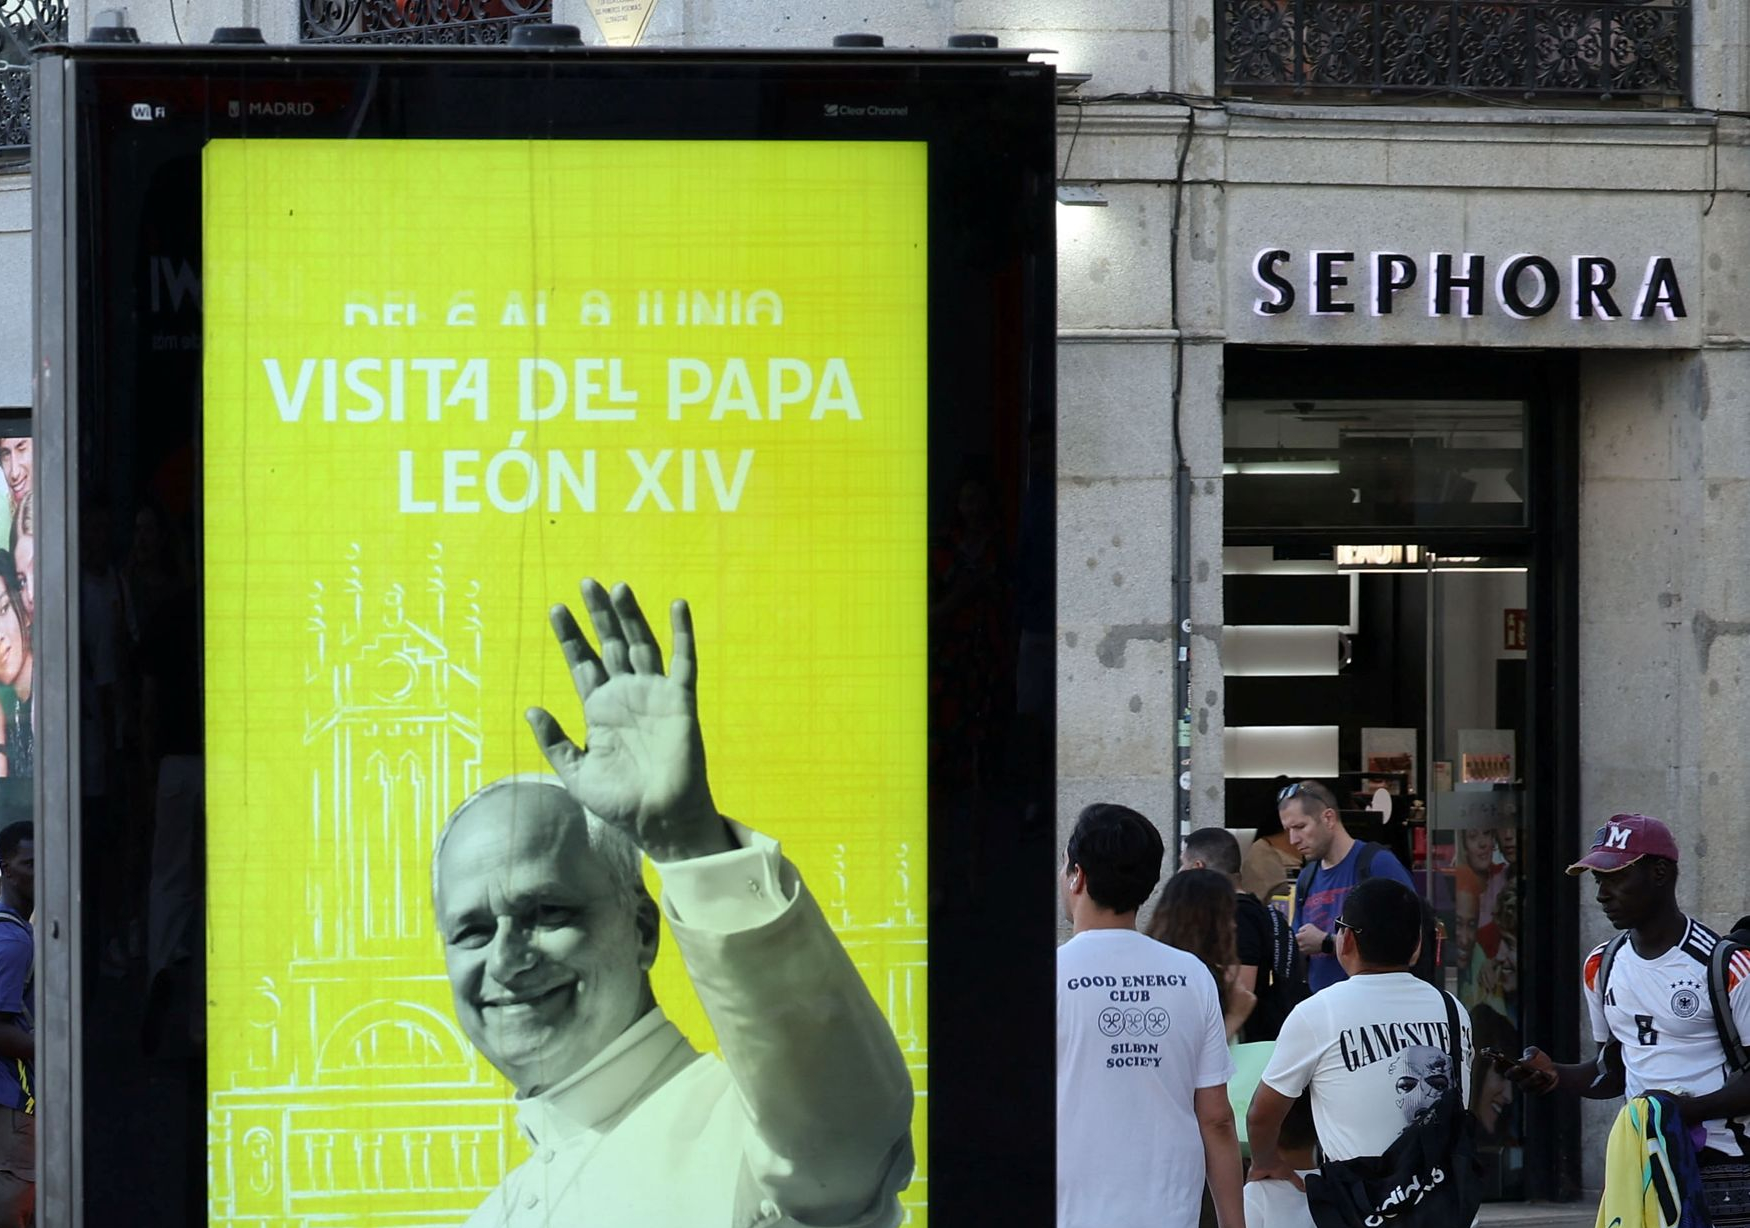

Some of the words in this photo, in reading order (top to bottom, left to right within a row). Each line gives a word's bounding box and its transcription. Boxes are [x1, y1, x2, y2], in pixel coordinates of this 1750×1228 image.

[249, 101, 314, 116] MADRID
[839, 104, 866, 116] Clear
[866, 104, 909, 116] Channel
[1252, 246, 1687, 321] SEPHORA
[262, 358, 489, 422] VISITA
[518, 358, 637, 422] DEL
[666, 358, 863, 422] PAPA
[398, 430, 597, 514] LEÓN
[623, 448, 755, 513] XIV
[1604, 827, 1633, 850] M
[1067, 975, 1117, 990] GOOD
[1122, 974, 1188, 988] ENERGY
[1109, 990, 1151, 1002] CLUB
[1106, 1056, 1163, 1068] SOCIETY
